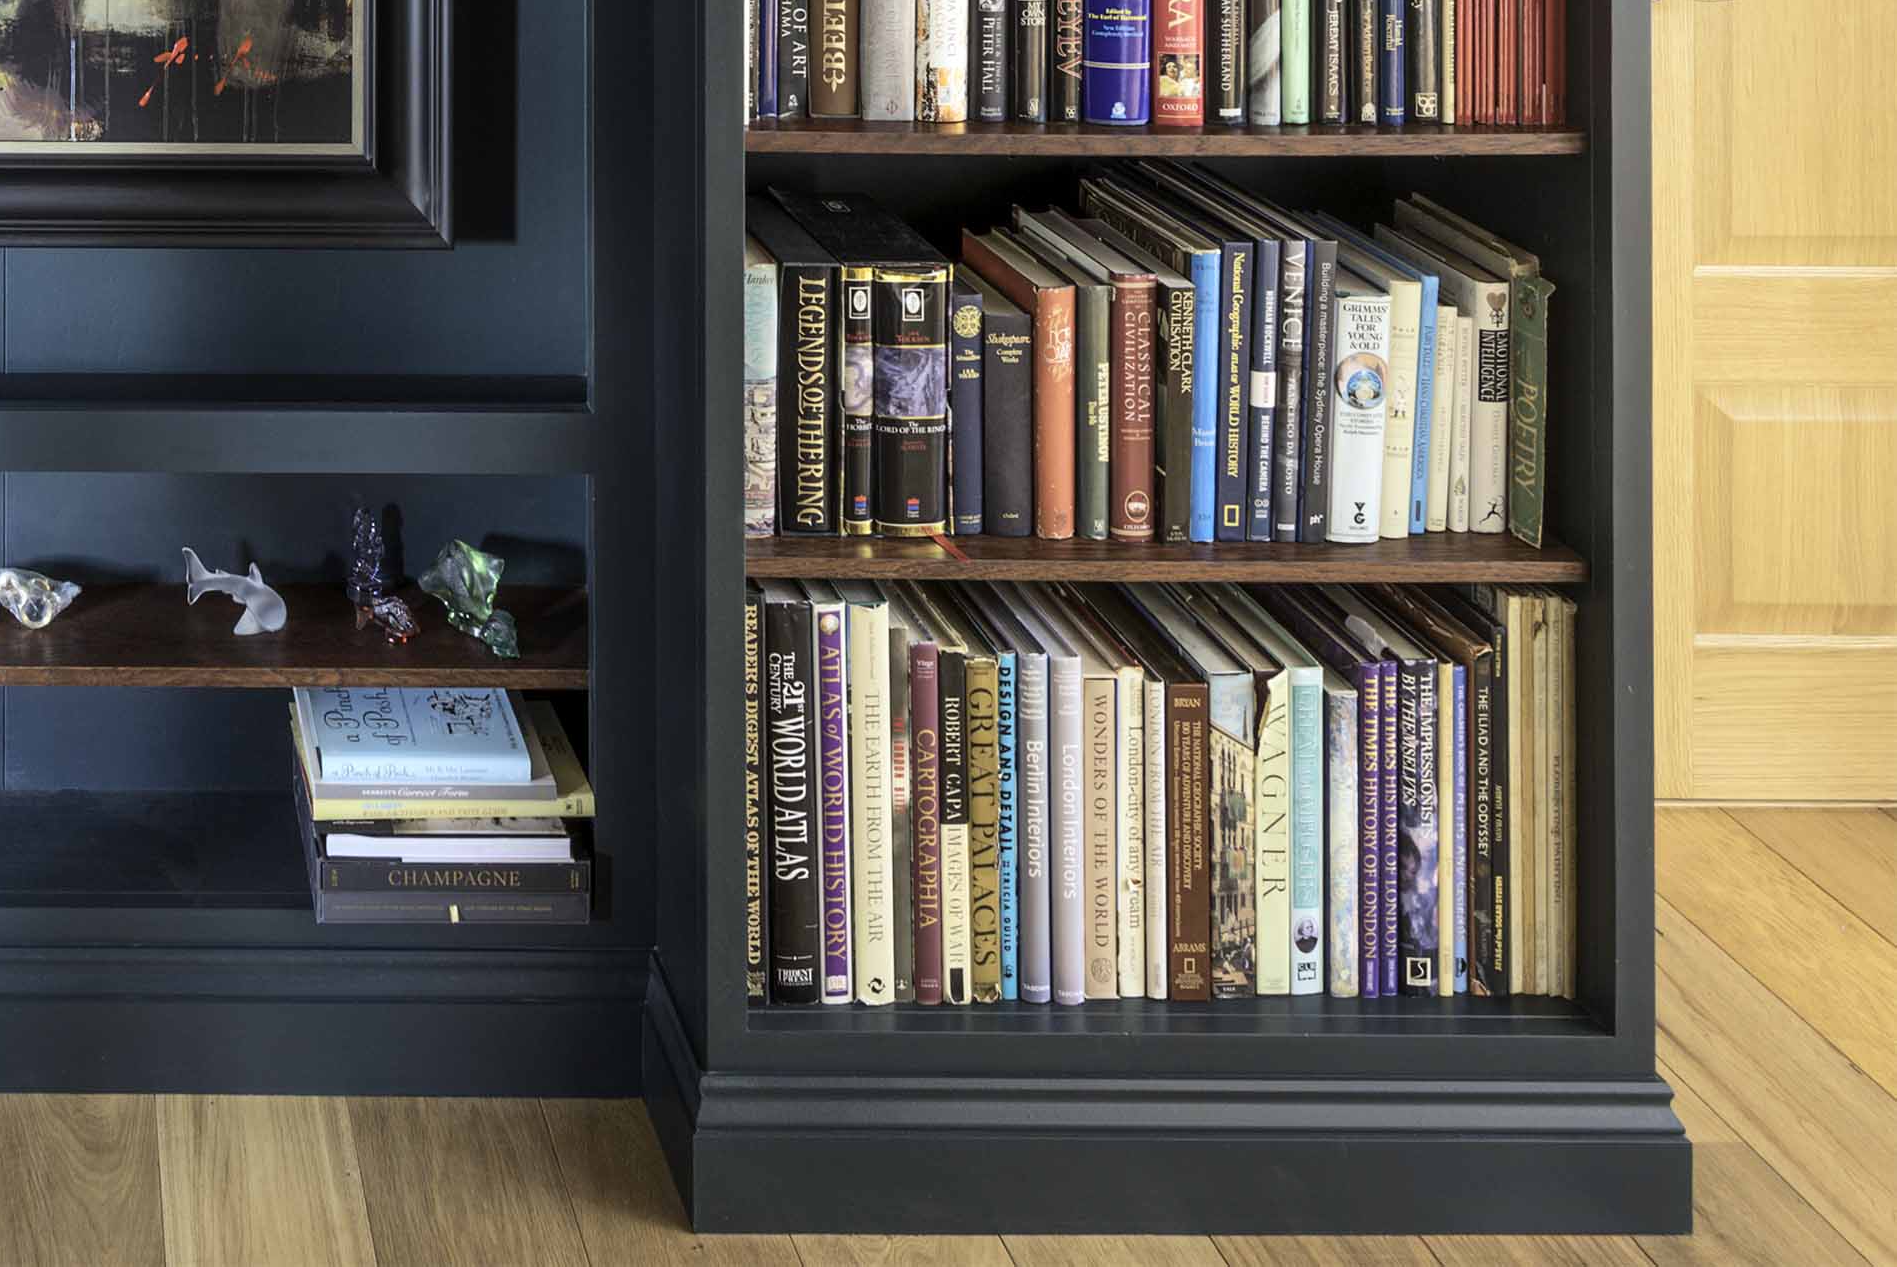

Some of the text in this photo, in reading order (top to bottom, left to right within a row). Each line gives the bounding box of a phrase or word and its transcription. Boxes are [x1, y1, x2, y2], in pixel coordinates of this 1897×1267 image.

[792, 7, 808, 33] OF
[792, 40, 808, 78] ART
[1170, 290, 1183, 372] CIVILISATION
[1282, 252, 1304, 350] VENICE
[1317, 261, 1331, 301] Building
[1124, 310, 1137, 423] CIVILIZATION
[1137, 310, 1152, 424] CLASSICAL
[1181, 290, 1194, 394] KENNETH CLARK
[1316, 311, 1329, 372] masterpiece:
[1317, 372, 1327, 387] the
[1479, 330, 1496, 402] INTELLIGENCE
[1496, 330, 1509, 402] EMOTIONAL
[1312, 424, 1324, 453] Opera
[1313, 389, 1327, 424] Sydney
[1514, 378, 1539, 497] POETRY
[1312, 455, 1323, 485] House
[771, 715, 810, 882] WORLD ATLAS
[820, 644, 846, 961] ATLAS of WORLD HISTORY
[999, 666, 1013, 853] DESIGN AND DETAIL
[1025, 740, 1045, 878] Berlin Interiors
[1261, 702, 1287, 900] WAGNER
[916, 728, 938, 929] CARTOGRAPHIA
[969, 686, 997, 967] GREAT PALACES
[1060, 742, 1082, 900] London Interiors
[1093, 693, 1110, 948] WONDERS OF THE WORLD
[1384, 674, 1398, 958] THE TIMES HISTORY OF LONDON
[387, 869, 521, 887] CHAMPAGNE
